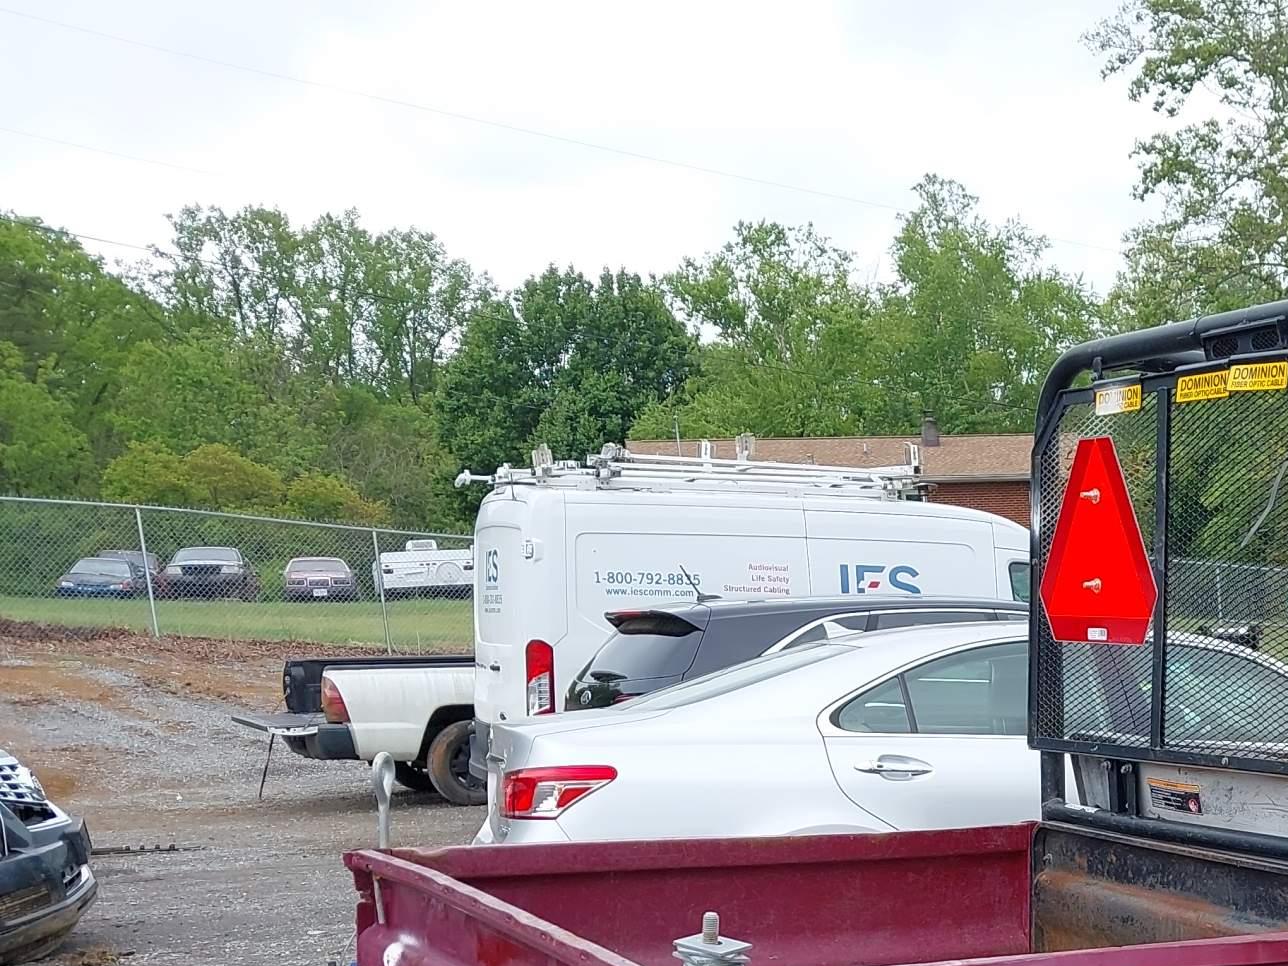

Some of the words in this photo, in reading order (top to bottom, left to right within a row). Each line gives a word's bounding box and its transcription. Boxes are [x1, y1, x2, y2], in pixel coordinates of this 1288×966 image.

[1233, 364, 1286, 380] DOMINION
[1180, 374, 1229, 392] DOMINION
[1231, 380, 1249, 388] FIBER
[1249, 380, 1266, 388] OPTIC
[1266, 379, 1284, 387] CABLE
[749, 563, 789, 572] Audiovisual
[595, 571, 701, 586] 1-800-792-8835
[752, 574, 766, 582] Life
[768, 575, 790, 585] Safety
[840, 564, 921, 594] IES
[605, 587, 694, 598] www.iescomm.com
[723, 584, 762, 593] Structured
[764, 586, 790, 596] Cabling
